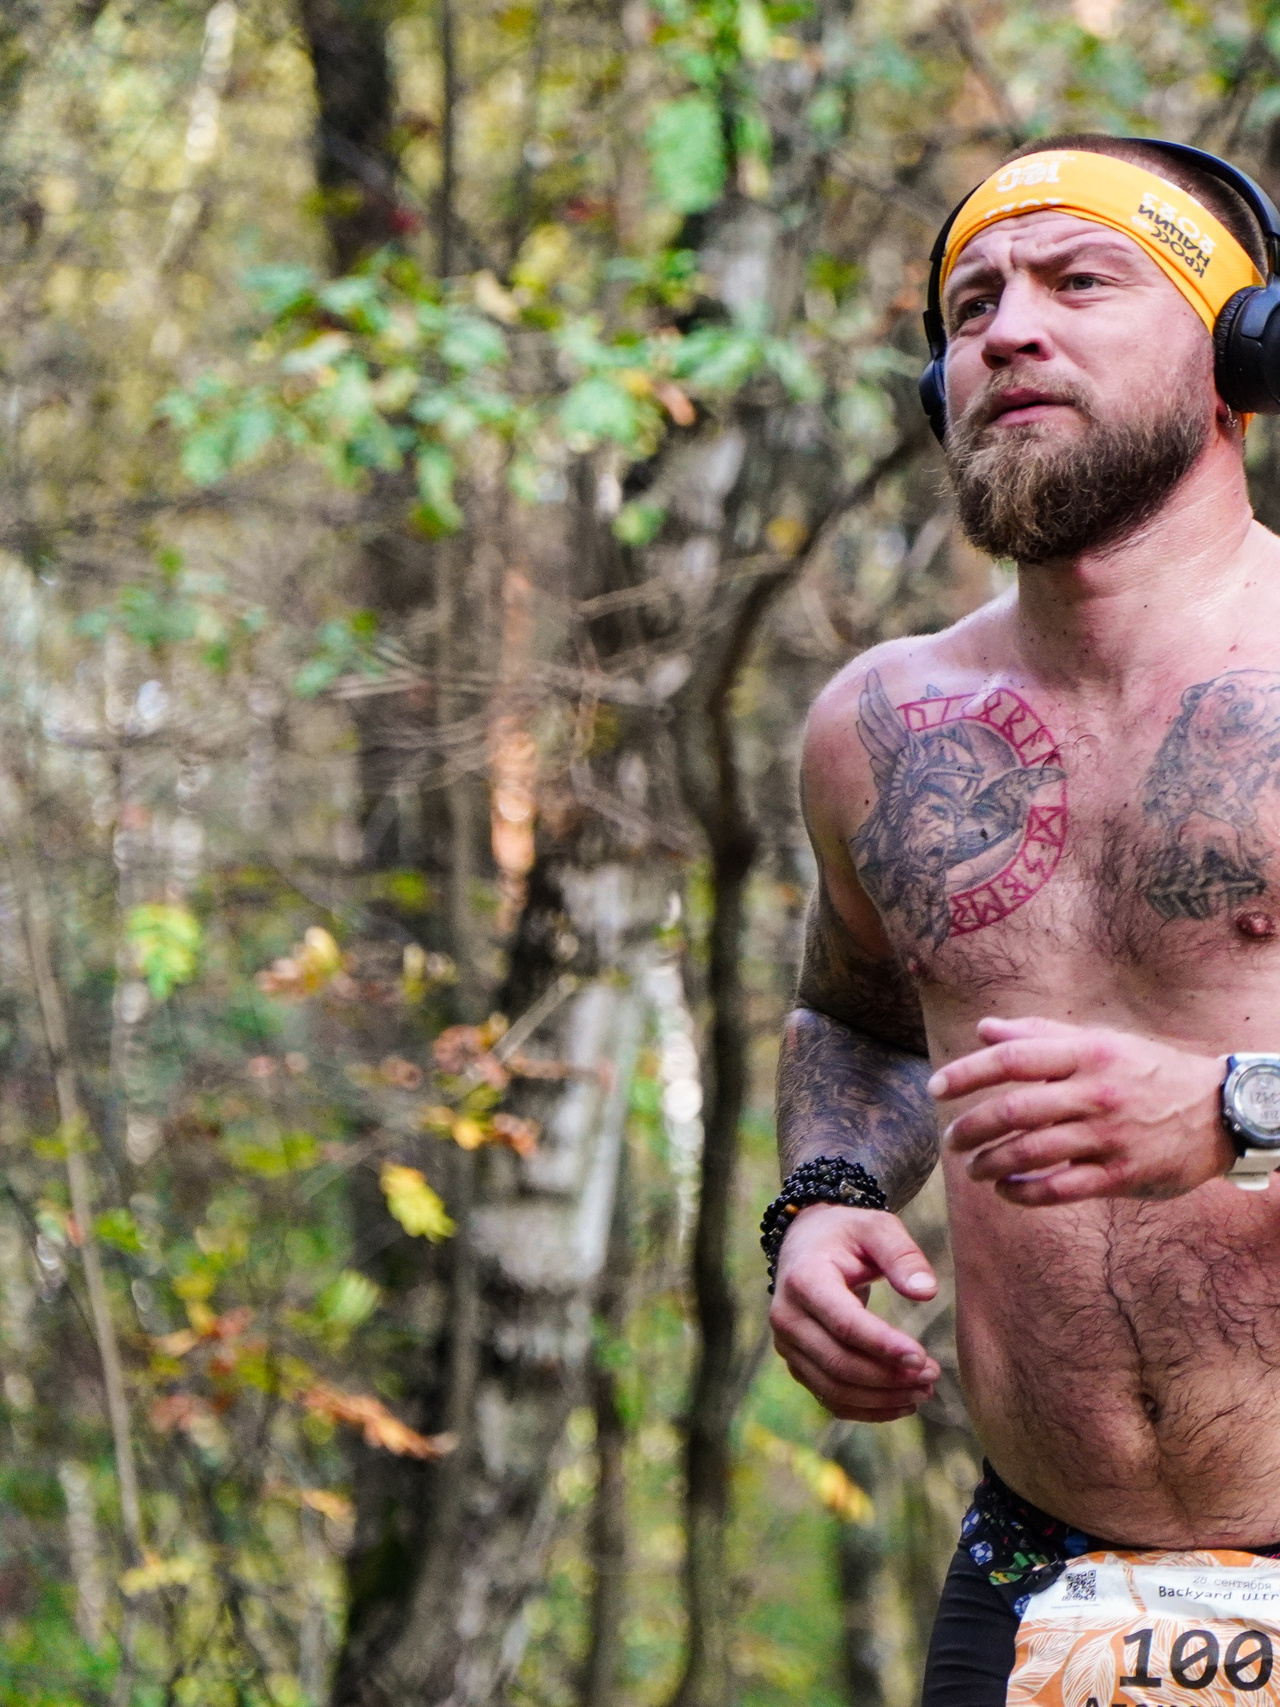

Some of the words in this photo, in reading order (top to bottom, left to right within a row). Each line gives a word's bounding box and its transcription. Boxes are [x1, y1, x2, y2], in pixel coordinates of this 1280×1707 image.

[1138, 204, 1210, 268] НАЦИИ
[1143, 192, 1216, 255] 2023
[1150, 226, 1206, 278] КРОСС
[1157, 1585, 1233, 1601] Backyard
[1213, 1578, 1272, 1592] сентября
[1119, 1628, 1274, 1692] 100
